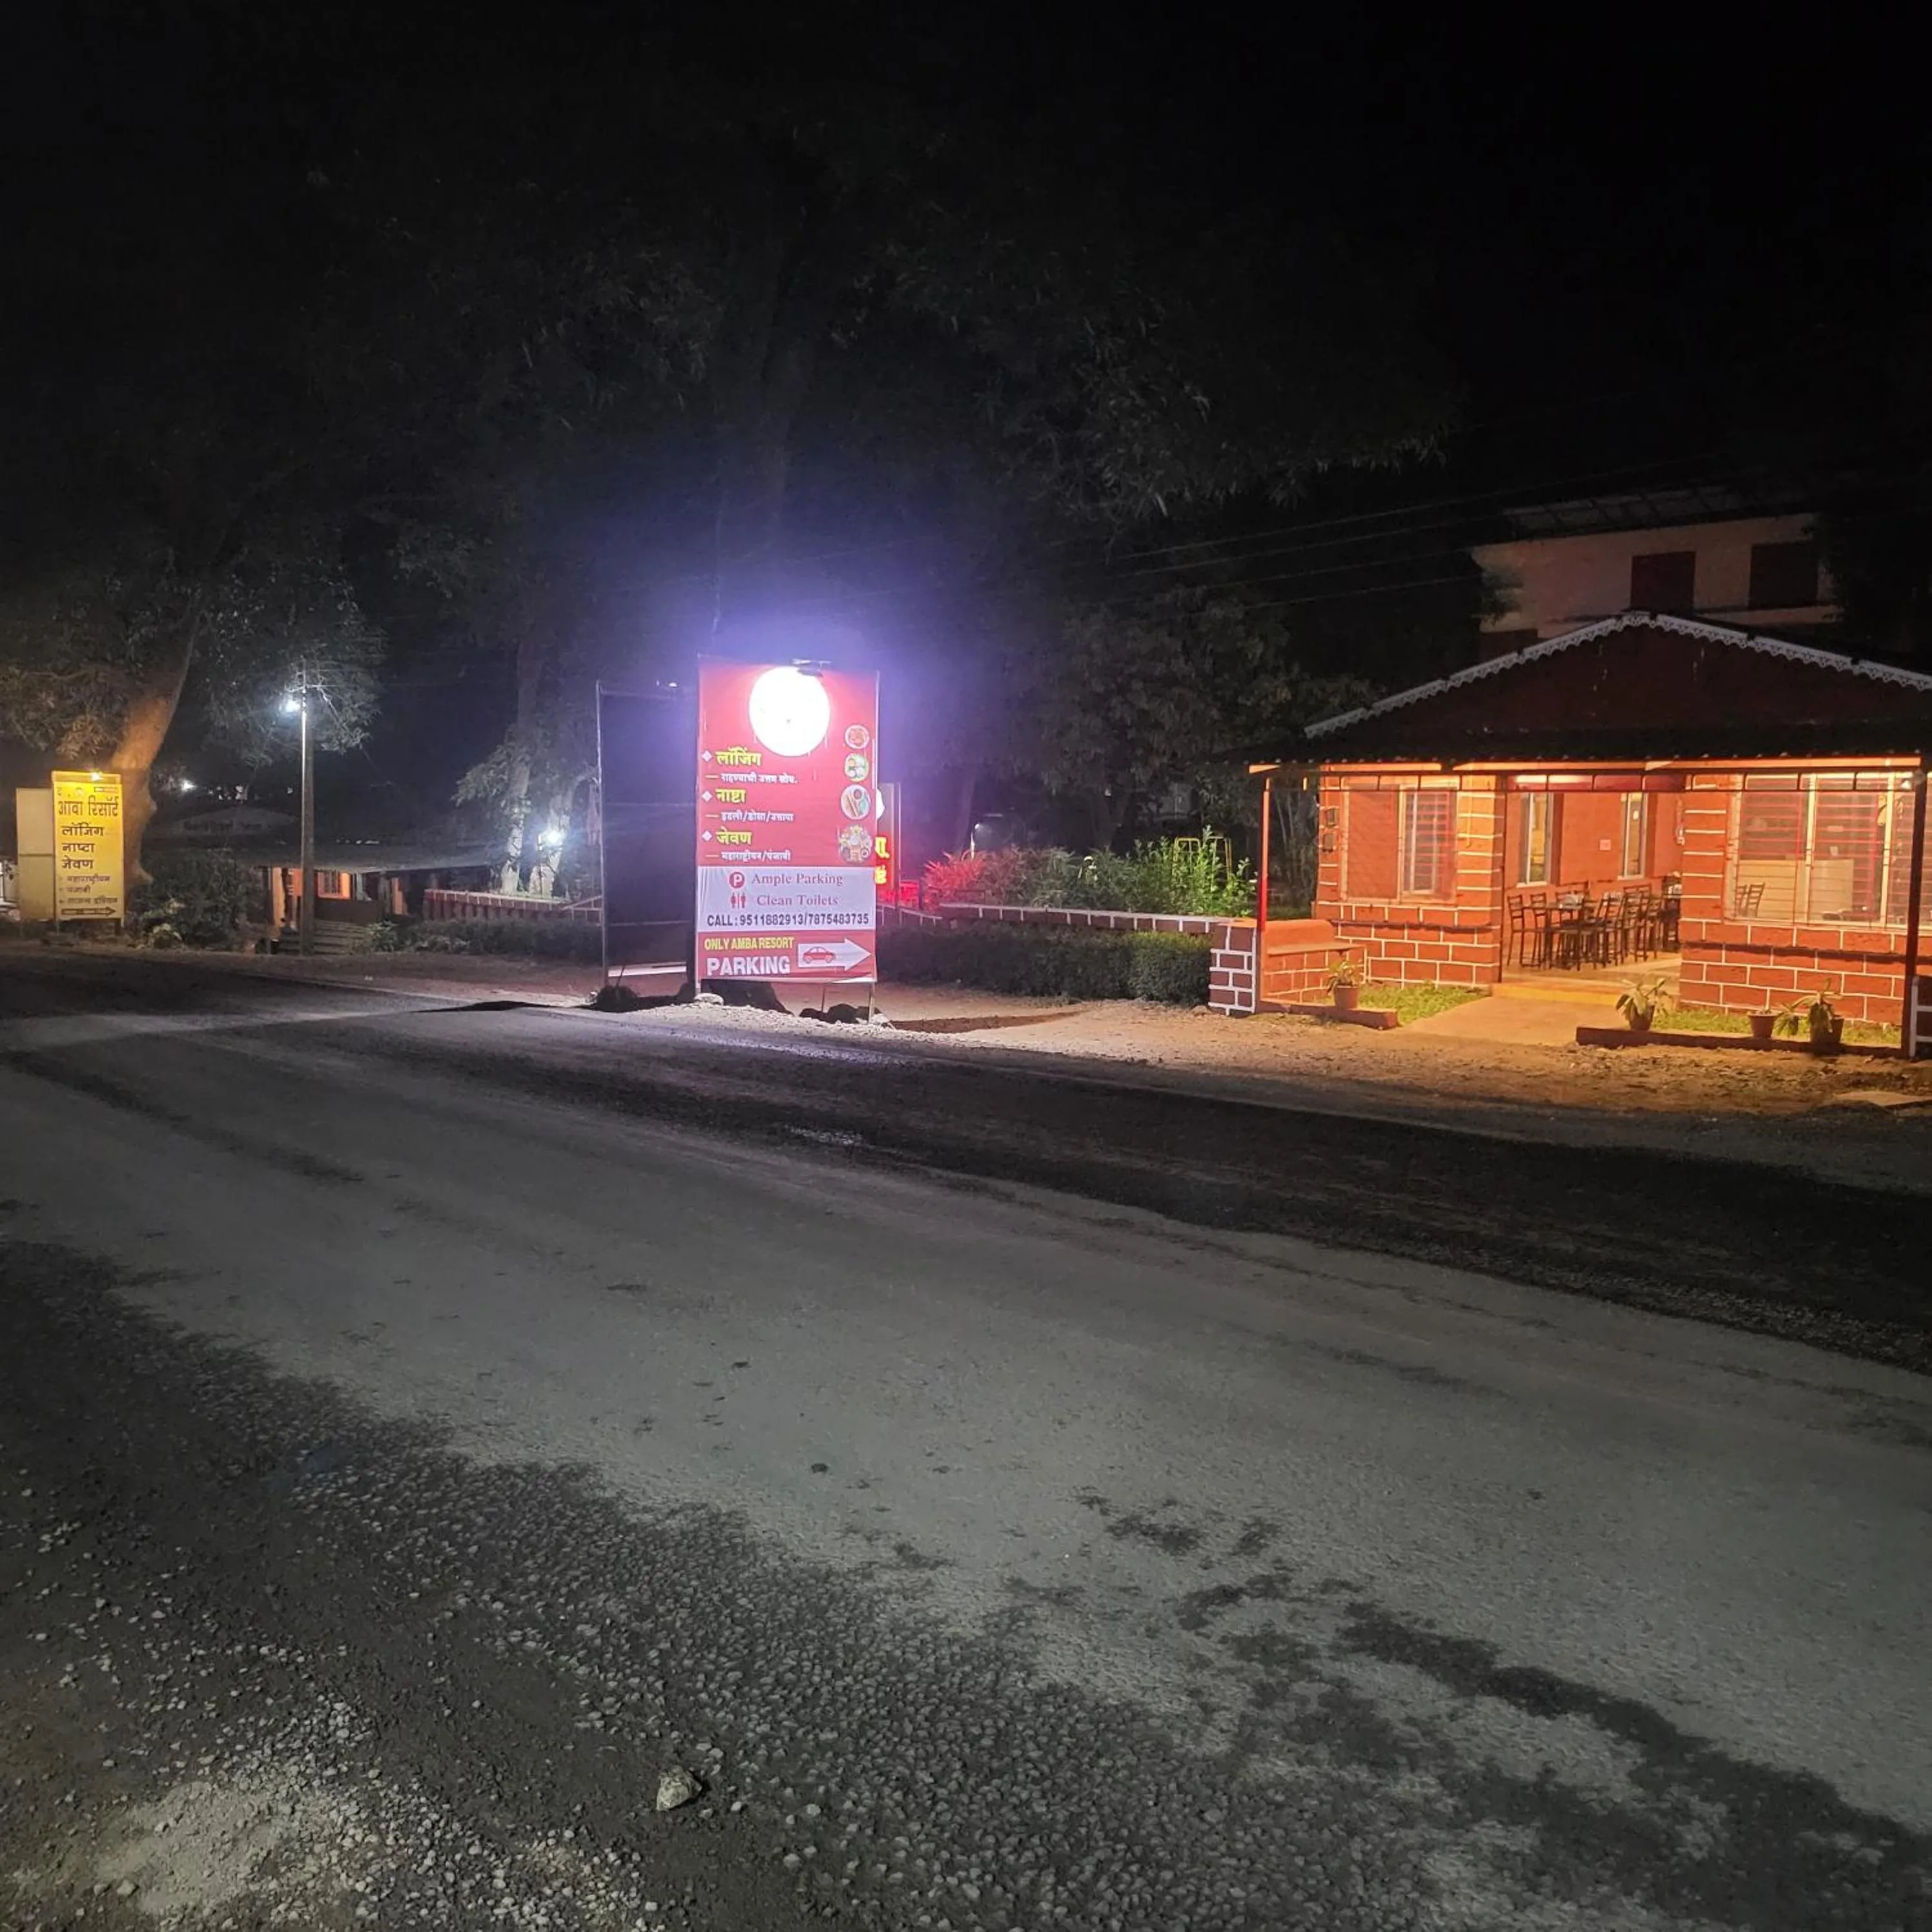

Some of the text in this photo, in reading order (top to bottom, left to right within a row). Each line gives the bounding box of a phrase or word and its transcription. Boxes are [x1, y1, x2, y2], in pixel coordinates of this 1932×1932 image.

[715, 826, 753, 845] जेवण
[61, 855, 94, 869] जेवण
[752, 872, 843, 887] Ample Parking
[757, 894, 838, 906] Clean Toilets
[704, 936, 794, 951] ONLY AMBA RESORT
[706, 956, 790, 976] PARKING
